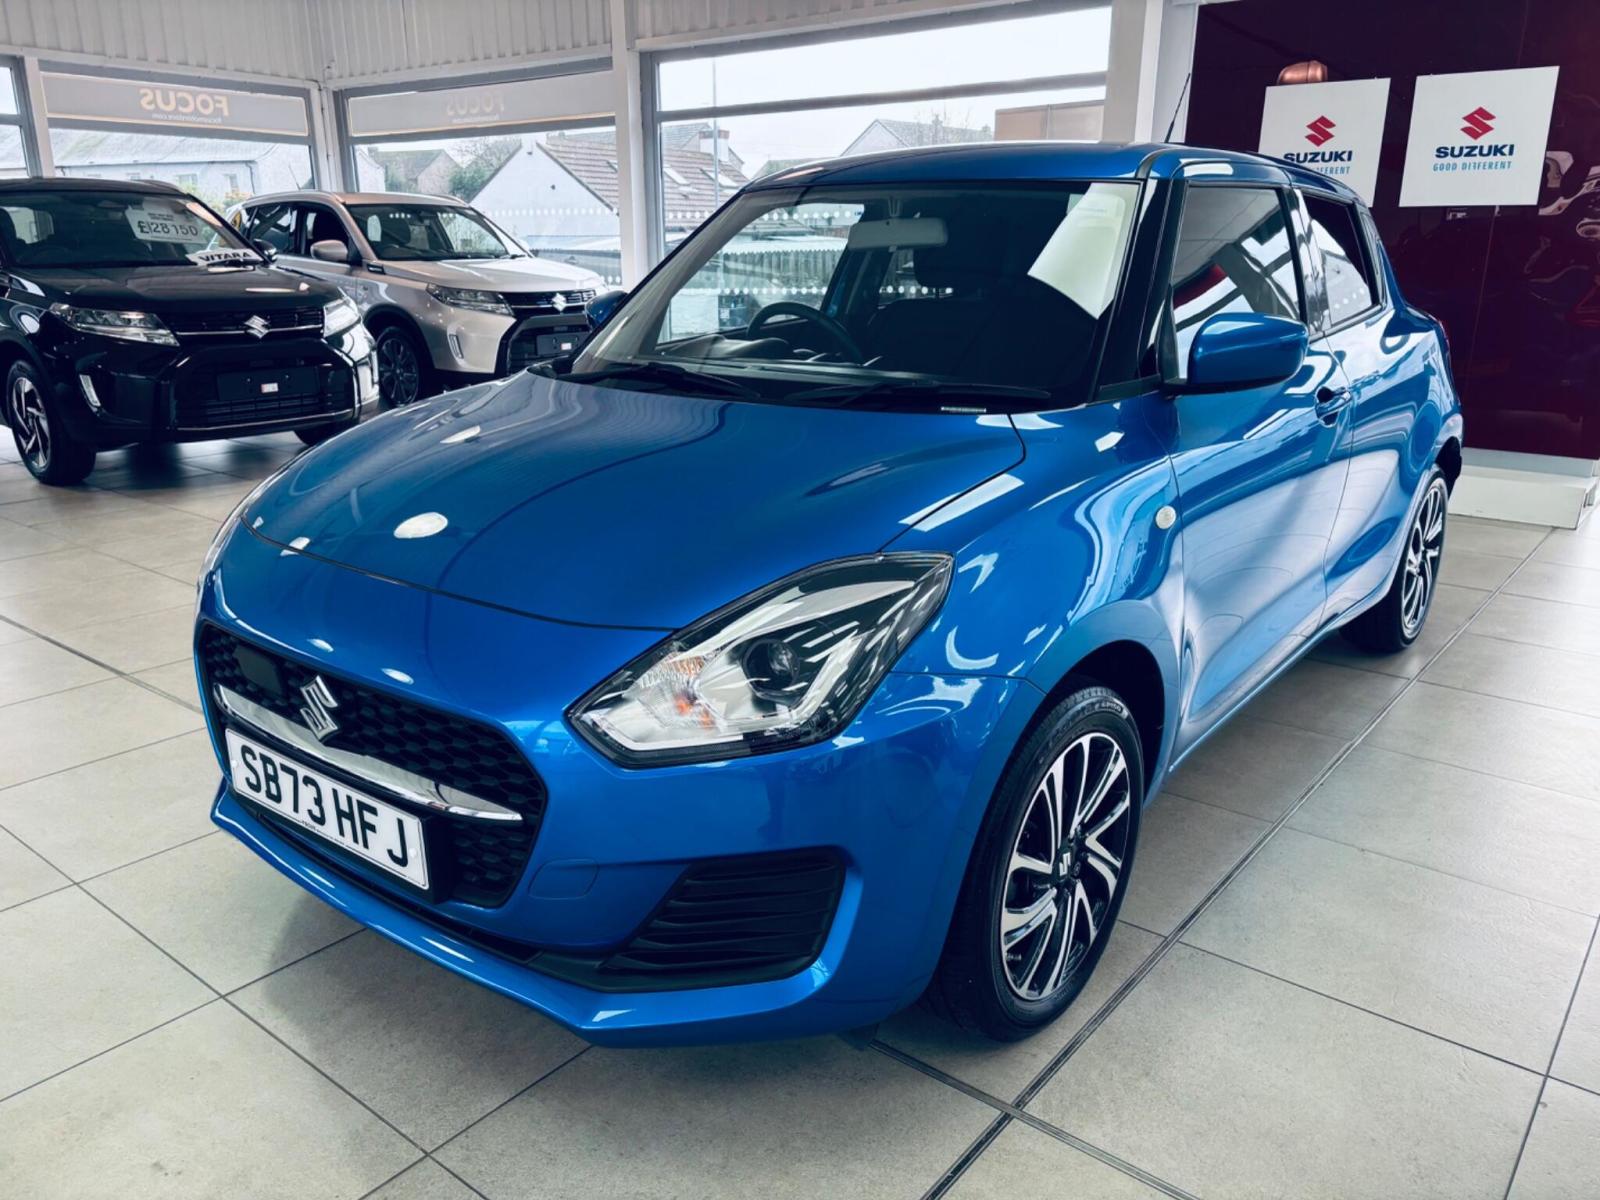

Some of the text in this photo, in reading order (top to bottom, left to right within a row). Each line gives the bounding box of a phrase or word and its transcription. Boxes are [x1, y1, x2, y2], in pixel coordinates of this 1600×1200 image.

[1283, 150, 1353, 163] SUZUKI
[1435, 143, 1515, 158] SUZUKI
[1317, 165, 1351, 175] FERENT
[1433, 161, 1513, 172] GOOD DIFFERENT
[198, 251, 252, 262] VITARA
[240, 744, 326, 826] SB73
